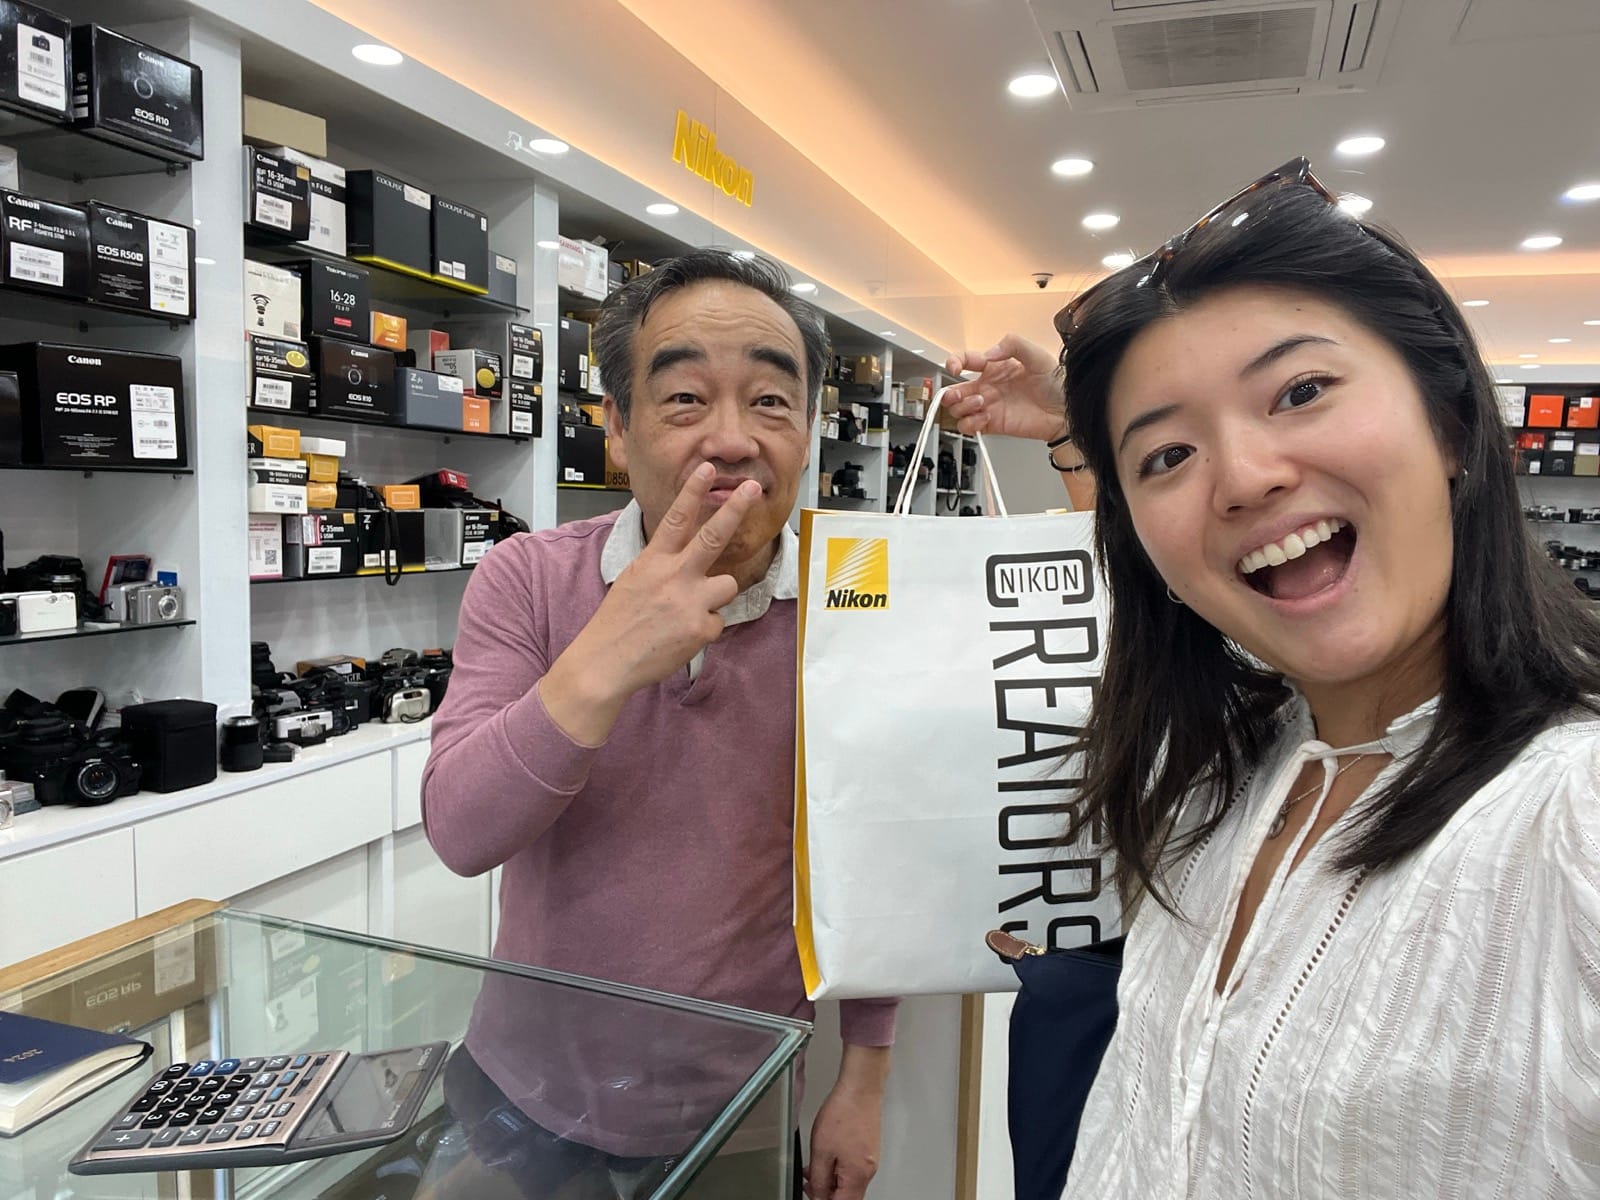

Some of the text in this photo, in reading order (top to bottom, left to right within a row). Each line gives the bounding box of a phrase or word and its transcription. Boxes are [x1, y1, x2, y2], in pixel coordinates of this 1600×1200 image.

[138, 51, 165, 68] Canon
[134, 107, 170, 127] EOS R10
[256, 153, 279, 167] Canon
[672, 109, 754, 208] Nikon
[7, 195, 40, 211] Canon
[9, 215, 33, 232] RF
[105, 216, 133, 230] Canon
[97, 244, 120, 257] EOS
[330, 289, 356, 306] 16-28
[67, 354, 102, 366] Canon
[350, 349, 369, 359] Canon
[56, 392, 117, 407] EOS RP
[348, 393, 362, 402] EOS
[606, 471, 631, 486] D850
[363, 514, 372, 524] Z
[1000, 563, 1079, 594] NIKON
[826, 589, 888, 608] Nikon
[193, 1062, 209, 1072] AC
[150, 1080, 169, 1091] 00
[190, 1094, 206, 1102] 5
[147, 1113, 163, 1121] 3
